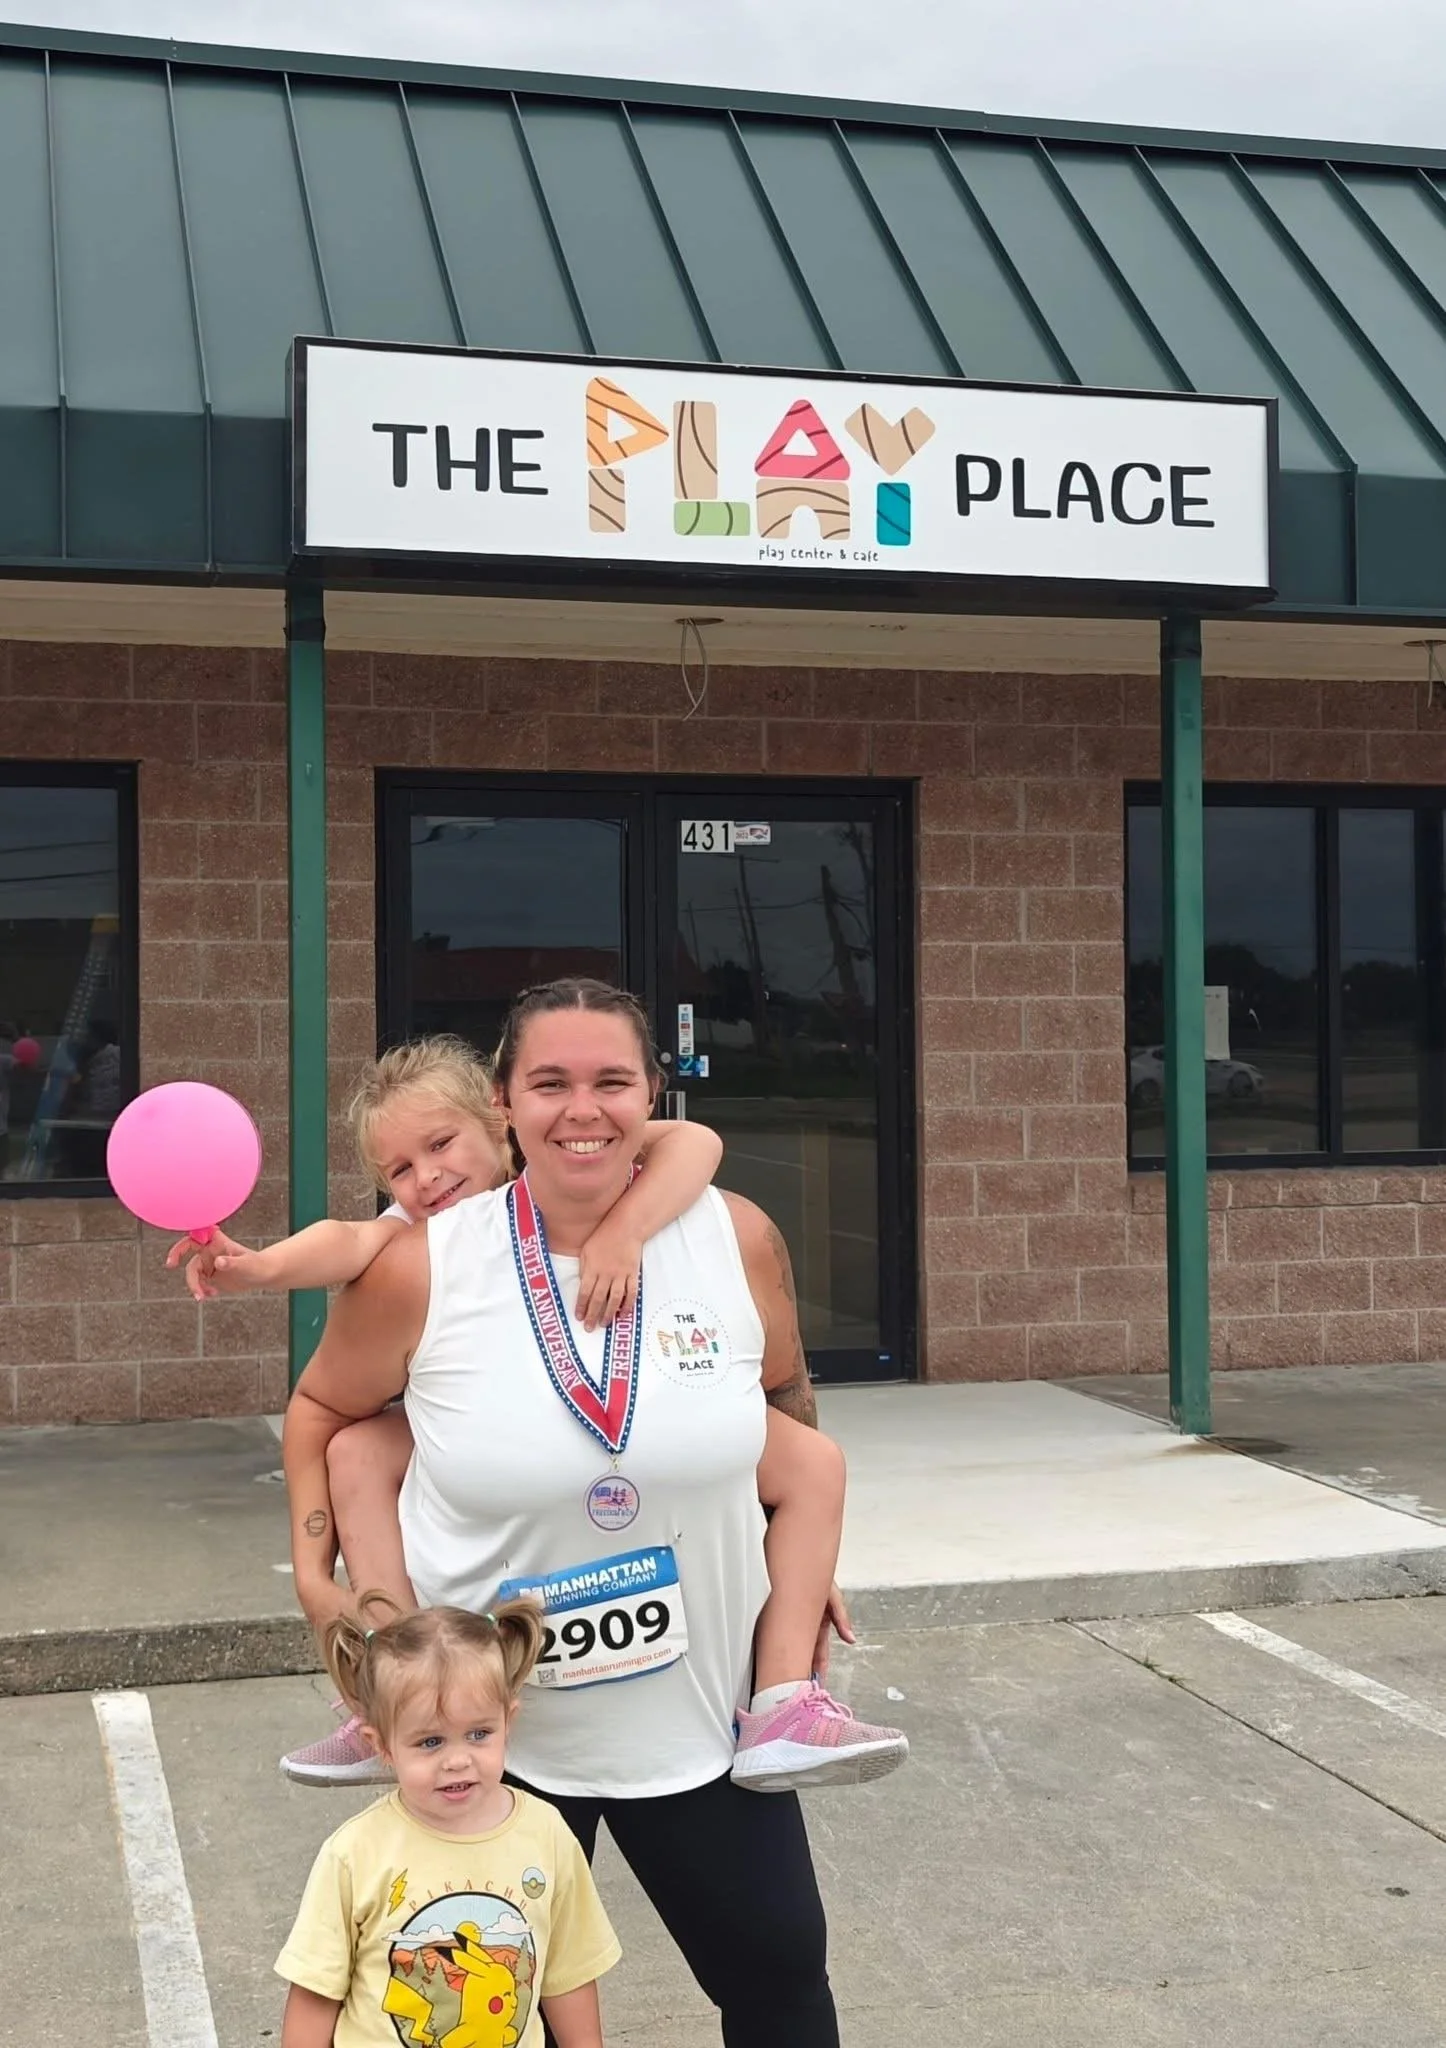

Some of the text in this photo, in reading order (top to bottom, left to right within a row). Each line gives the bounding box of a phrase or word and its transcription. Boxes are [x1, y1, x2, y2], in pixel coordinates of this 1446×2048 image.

[372, 376, 1215, 546] THE PLAY PLACE
[759, 545, 784, 560] play
[791, 548, 833, 559] center
[839, 549, 846, 559] &
[683, 822, 729, 851] 431
[521, 1233, 582, 1392] 50TH ANNIVERSARY
[673, 1313, 696, 1324] THE
[656, 1327, 719, 1358] PLAY
[679, 1360, 714, 1371] PLACE
[544, 1556, 657, 1597] MANHATTAN
[547, 1571, 657, 1606] RUNNING COMPANY
[536, 1600, 670, 1664] 2909
